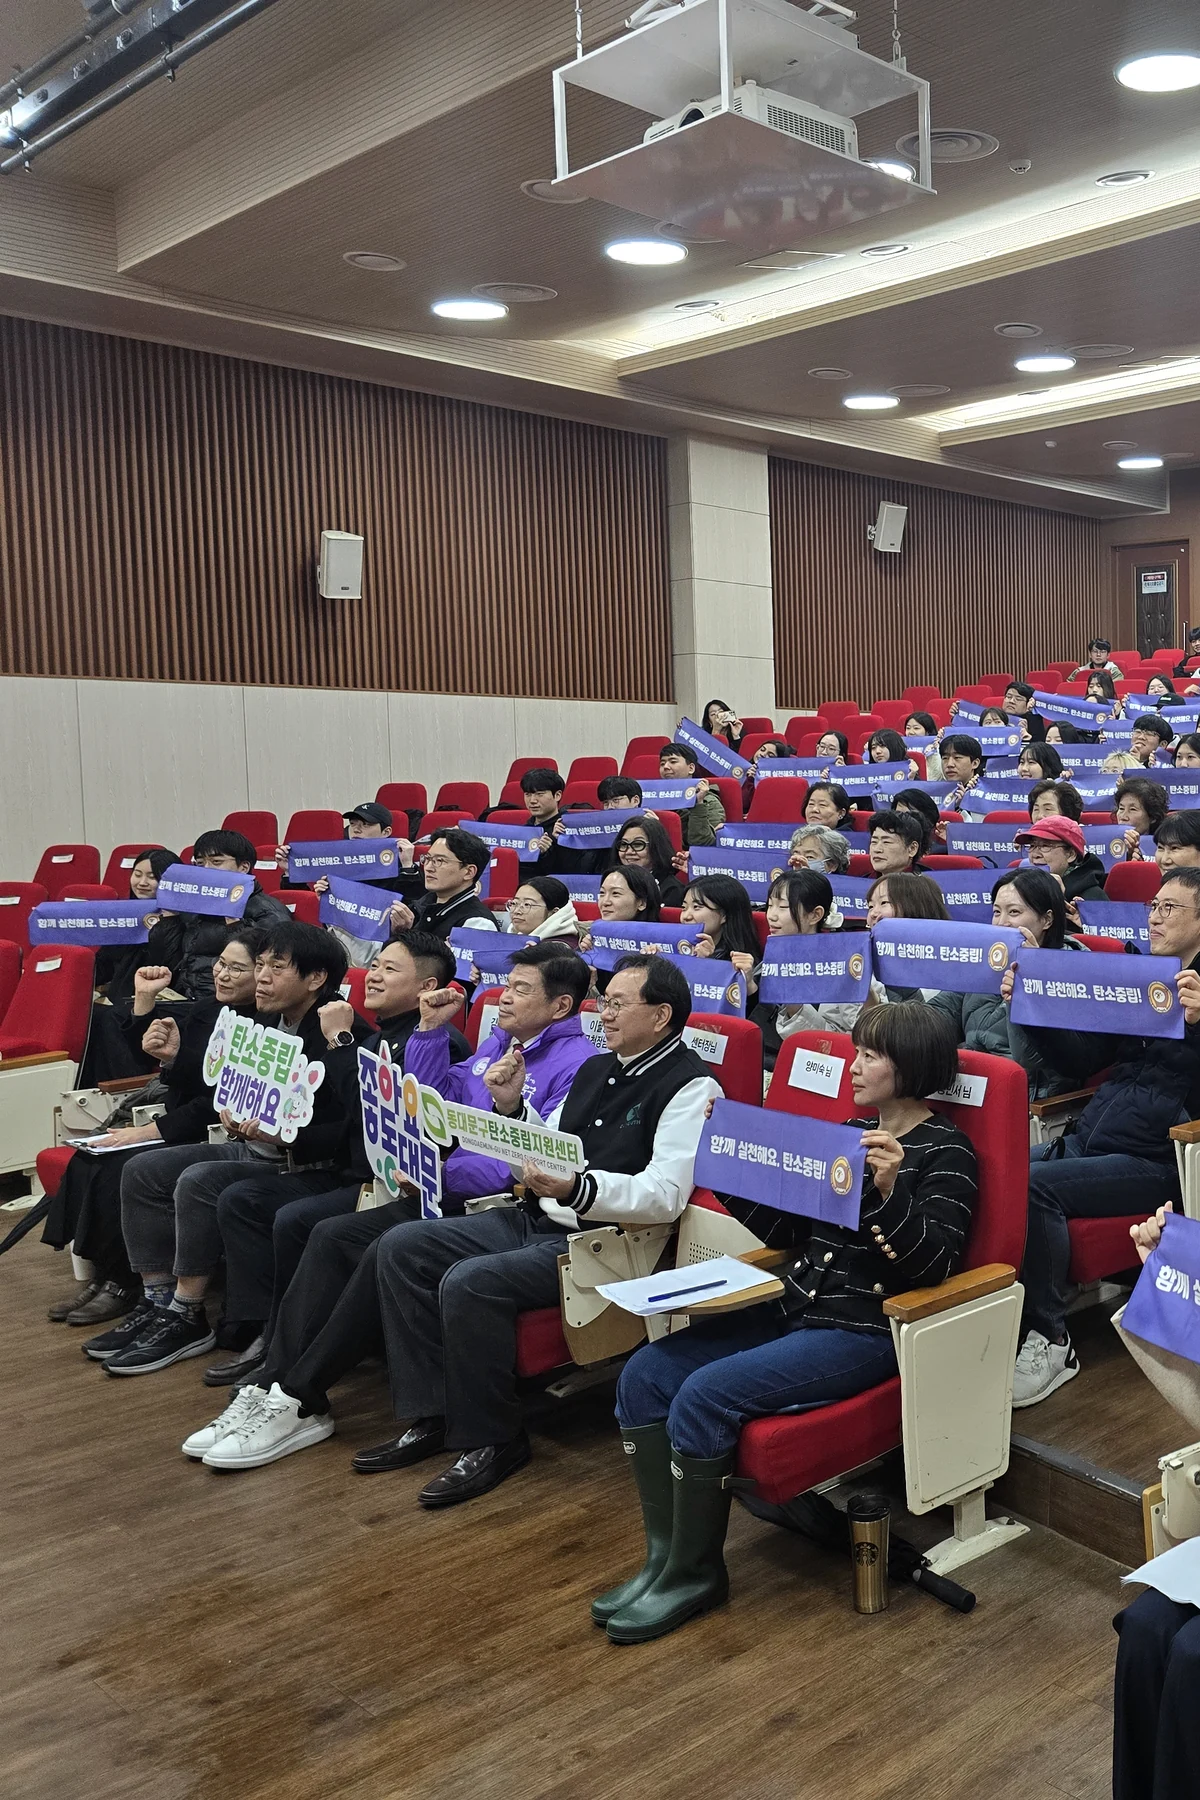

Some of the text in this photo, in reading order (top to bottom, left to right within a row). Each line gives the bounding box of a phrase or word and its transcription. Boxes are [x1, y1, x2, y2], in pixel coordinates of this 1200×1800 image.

[1048, 703, 1069, 714] 실천해요.
[1071, 708, 1094, 720] 탄소중립!
[679, 729, 732, 771] 함께 실천해요. 탄소중립!
[970, 789, 984, 798] 함께
[985, 791, 1010, 802] 실천해요.
[1170, 785, 1198, 794] 탄소중립!
[877, 793, 889, 802] 함께
[579, 827, 603, 835] 실천해요.
[501, 839, 525, 848] 탄소중립!
[720, 838, 766, 848] 함께 실천해요.
[952, 840, 964, 850] 함께
[966, 841, 992, 851] 실천해요.
[294, 855, 375, 867] 함께 실천해요. 탄소중립!
[692, 866, 706, 875] 함께
[738, 871, 767, 882] 탄소중립!
[158, 880, 228, 897] 함께 실천해요. 탄소중립!
[947, 892, 981, 905] 실천해요.
[38, 917, 138, 928] 함께 실천해요. 탄소중립!
[609, 938, 639, 951] 실천해요.
[876, 942, 983, 962] 함께 실천해요. 탄소중립!
[762, 962, 845, 976] 함께 실천해요. 탄소중립!
[481, 973, 498, 984] 함께
[1023, 977, 1142, 1003] 함께 실천해요. 탄소중립!
[691, 1036, 717, 1053] 센터장님
[228, 1024, 297, 1085] 탄소중립
[218, 1065, 280, 1126] 함께해요
[446, 1108, 579, 1165] 동대문구탄소중립지원센터
[461, 1136, 501, 1154] DONGDAEMUN-GU
[502, 1148, 510, 1157] NET
[511, 1150, 523, 1161] ZERO
[547, 1161, 566, 1173] CENTER
[710, 1135, 826, 1180] 함께 실천해요. 탄소중립!
[1156, 1264, 1189, 1300] 함께
